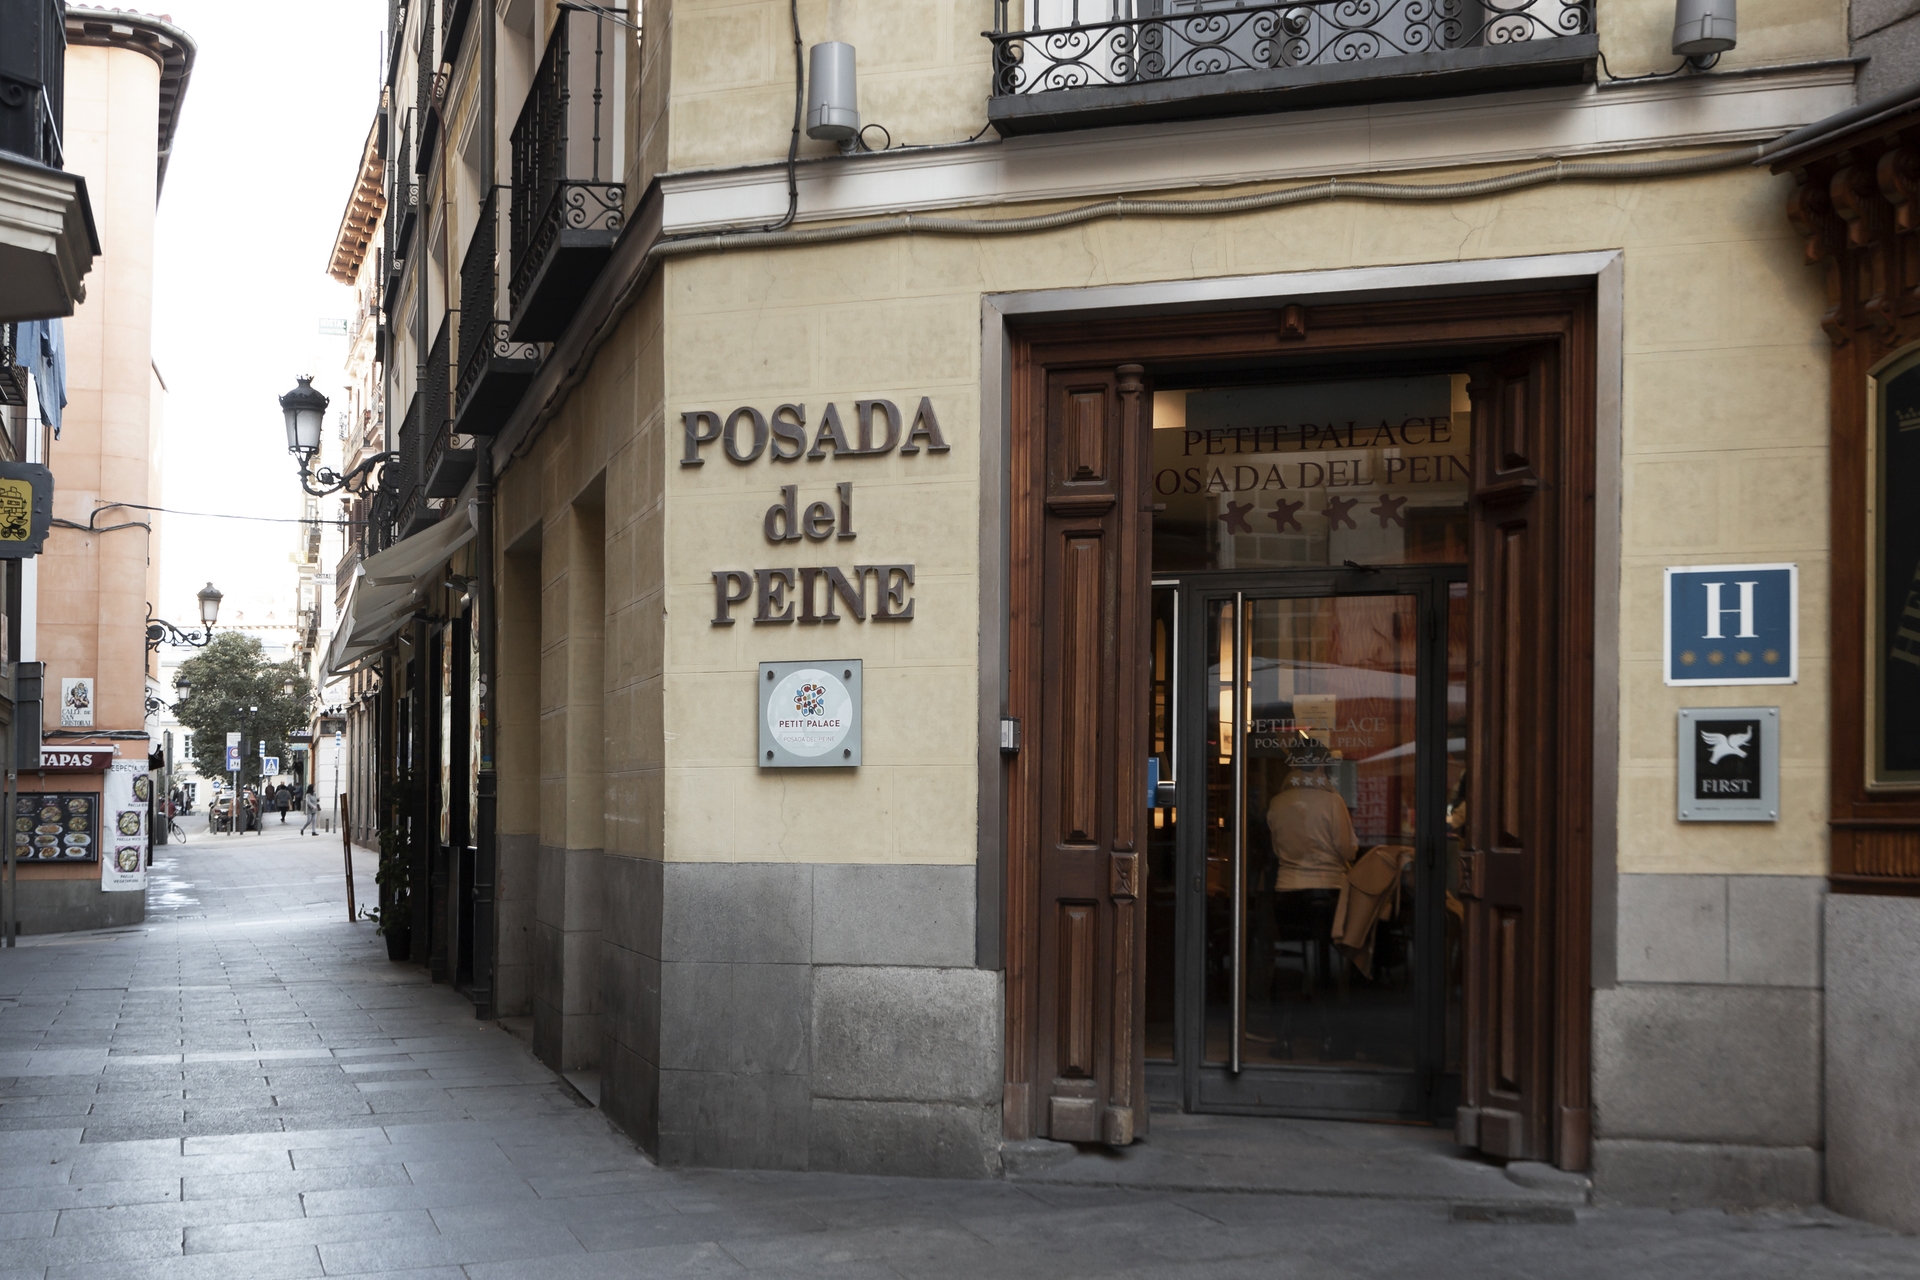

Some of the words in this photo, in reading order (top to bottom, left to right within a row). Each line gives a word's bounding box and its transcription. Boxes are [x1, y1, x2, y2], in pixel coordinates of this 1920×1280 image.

[680, 396, 951, 465] POSADA
[1182, 424, 1288, 456] PETIT
[1297, 416, 1452, 450] PALACE
[1150, 463, 1288, 496] OSADA
[1297, 459, 1375, 489] DEL
[764, 481, 857, 541] del
[711, 564, 916, 624] PEINE
[1701, 581, 1760, 639] H
[1245, 718, 1298, 735] PETIT
[1305, 716, 1387, 733] PALACE
[1254, 738, 1307, 749] POSADA
[1337, 737, 1376, 748] PEINE
[40, 754, 93, 767] TAPAS
[1284, 752, 1343, 765] hoteles
[1702, 779, 1751, 793] FIRST
